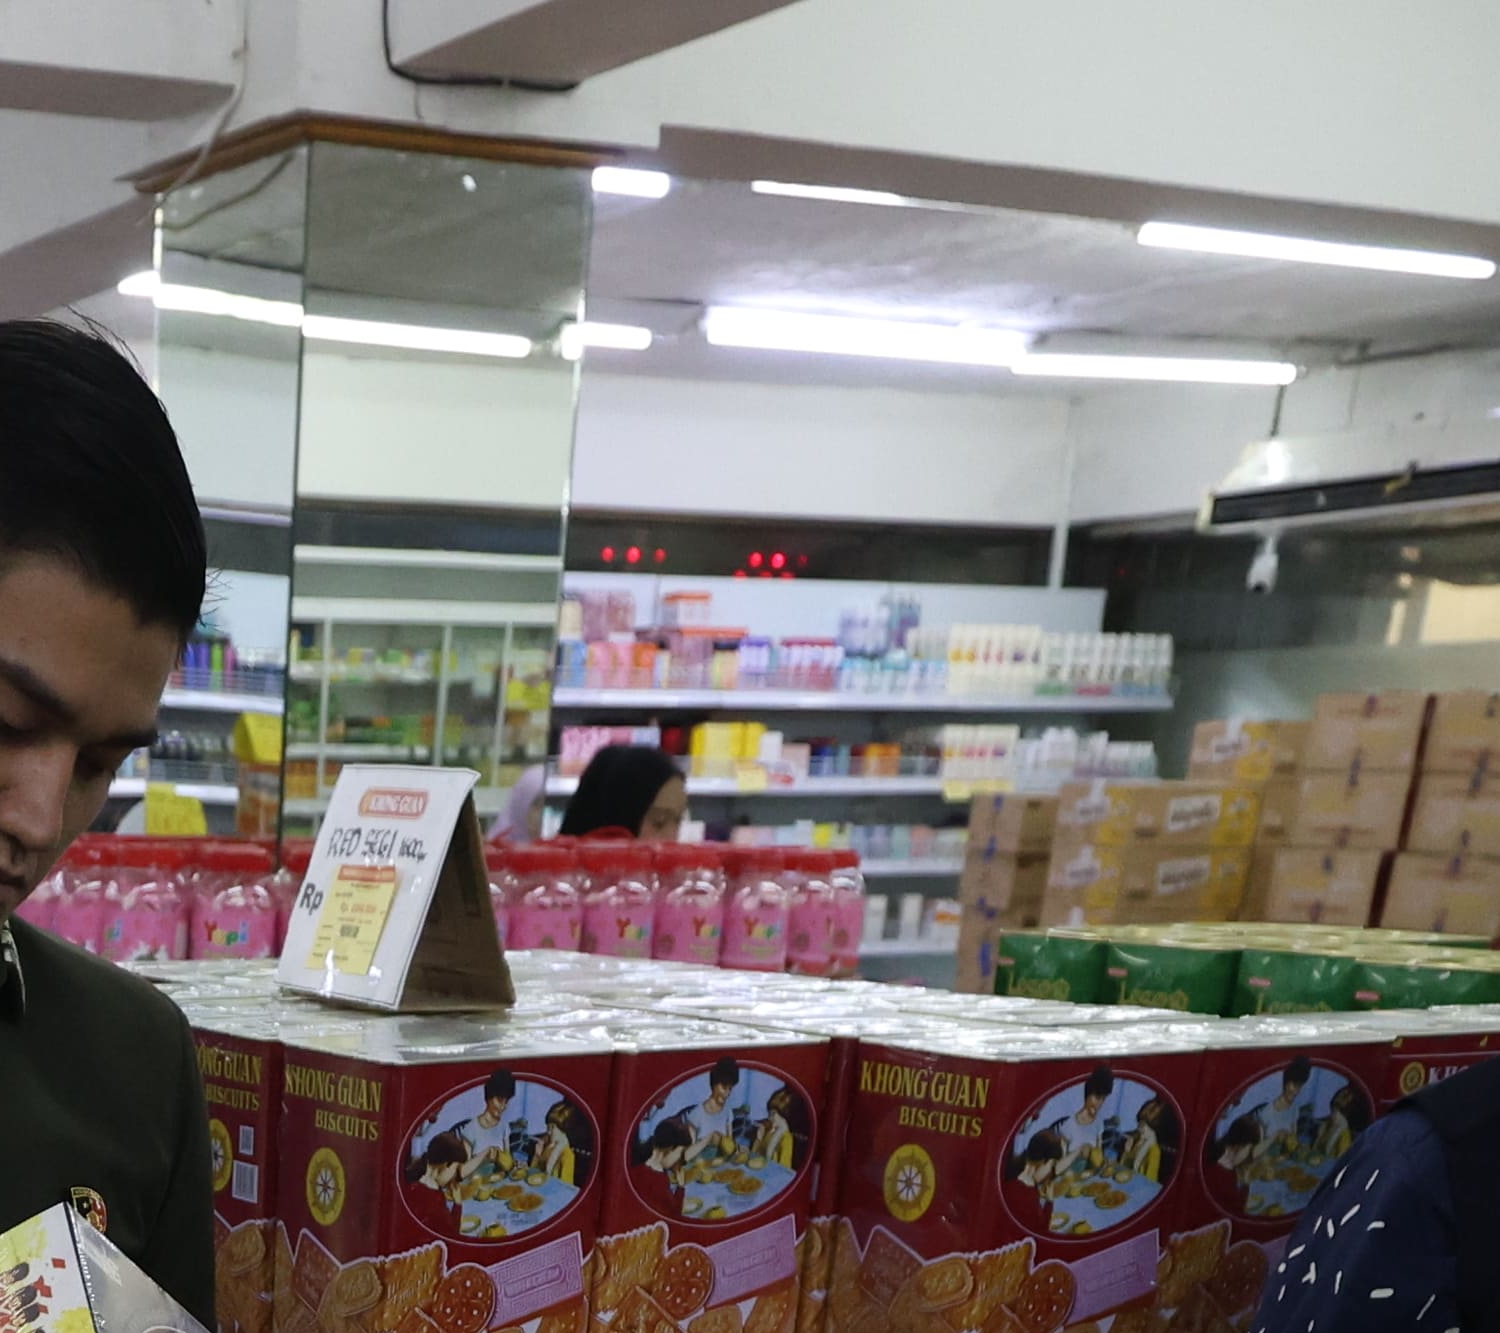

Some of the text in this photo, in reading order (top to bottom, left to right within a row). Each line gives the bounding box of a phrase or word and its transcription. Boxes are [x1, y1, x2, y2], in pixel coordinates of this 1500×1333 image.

[300, 882, 324, 916] Rp
[196, 1044, 262, 1085] ONG GUAN
[338, 1074, 383, 1113] GUAN
[860, 1059, 991, 1111] KHONG GUAN
[315, 1108, 379, 1141] BISCUITS
[899, 1106, 984, 1139] BISCUITS
